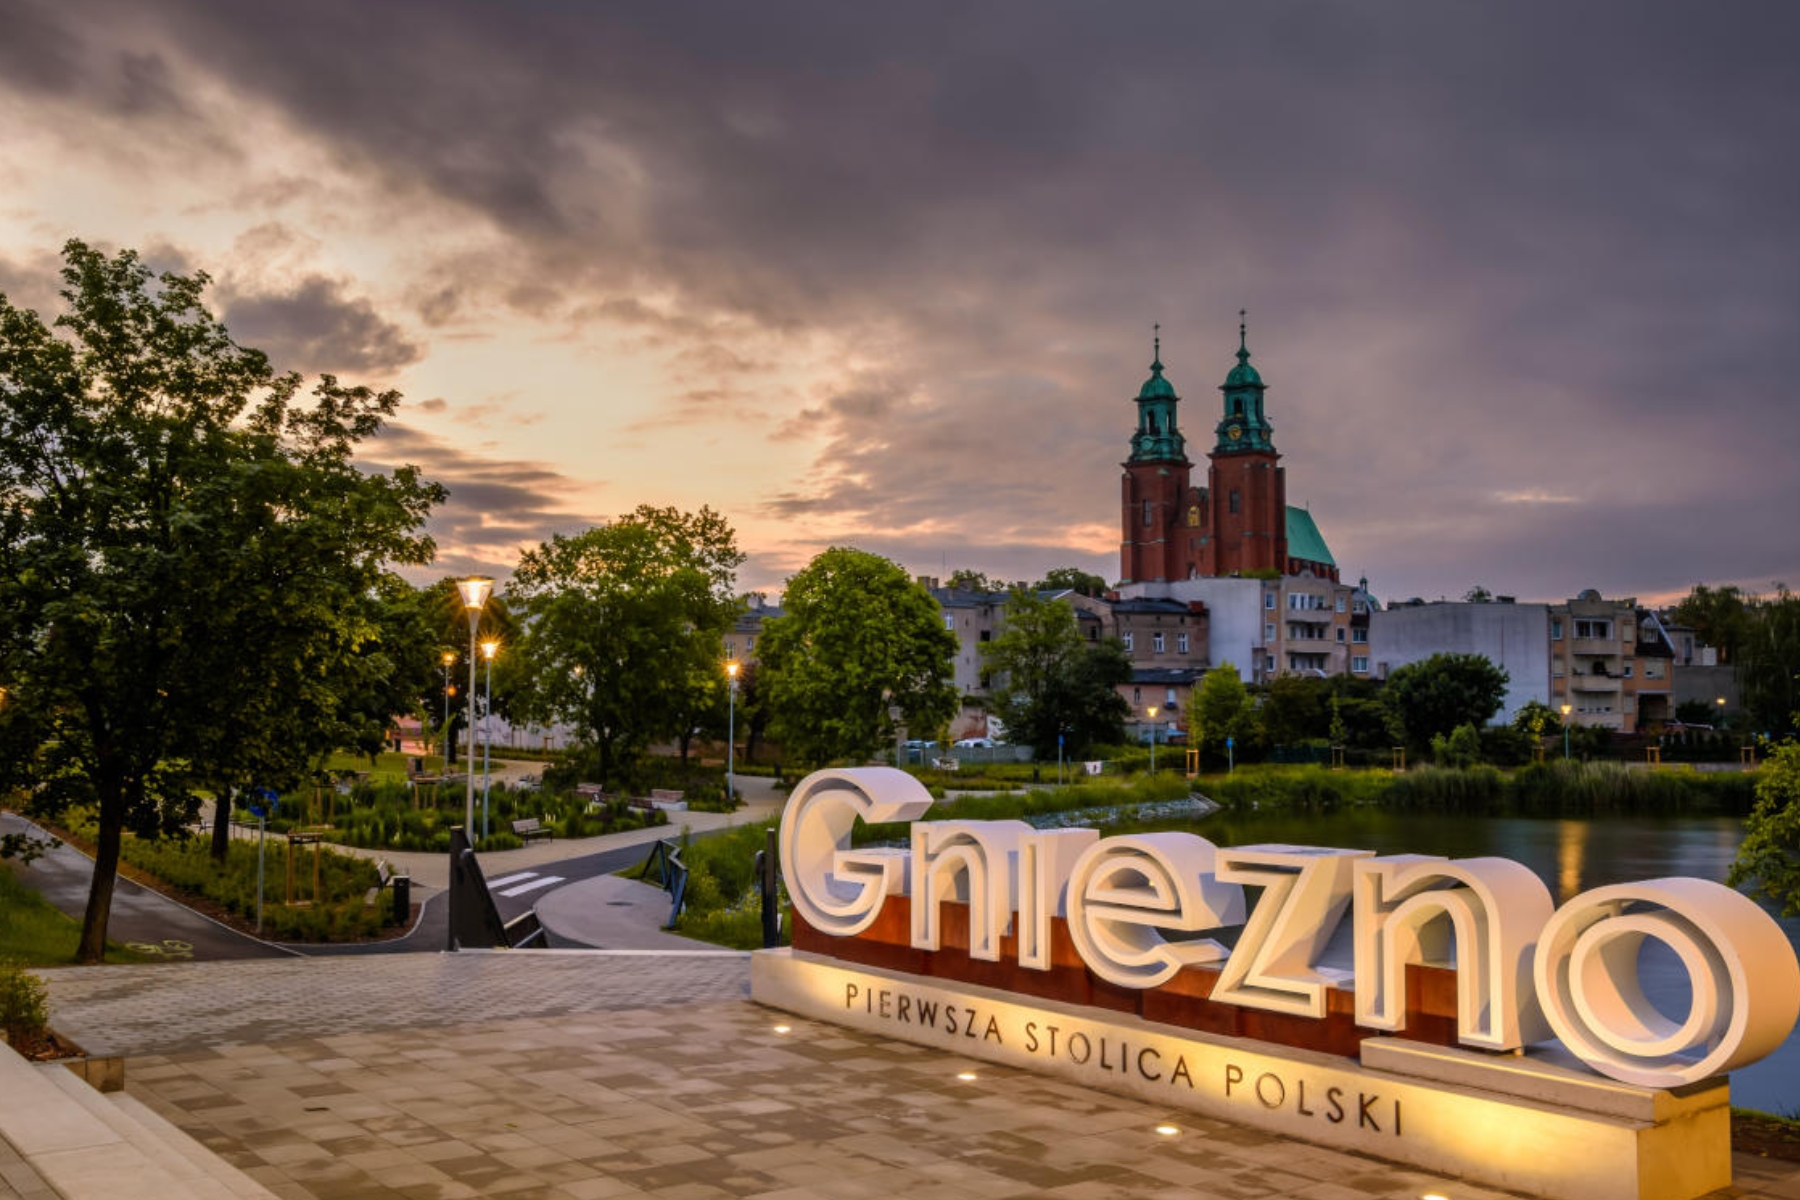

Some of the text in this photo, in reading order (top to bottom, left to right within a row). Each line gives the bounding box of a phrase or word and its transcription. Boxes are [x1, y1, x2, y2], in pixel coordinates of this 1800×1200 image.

[780, 766, 1800, 1087] Gniezno
[846, 983, 1401, 1136] PIERWSZA STOLICA POLSKI
